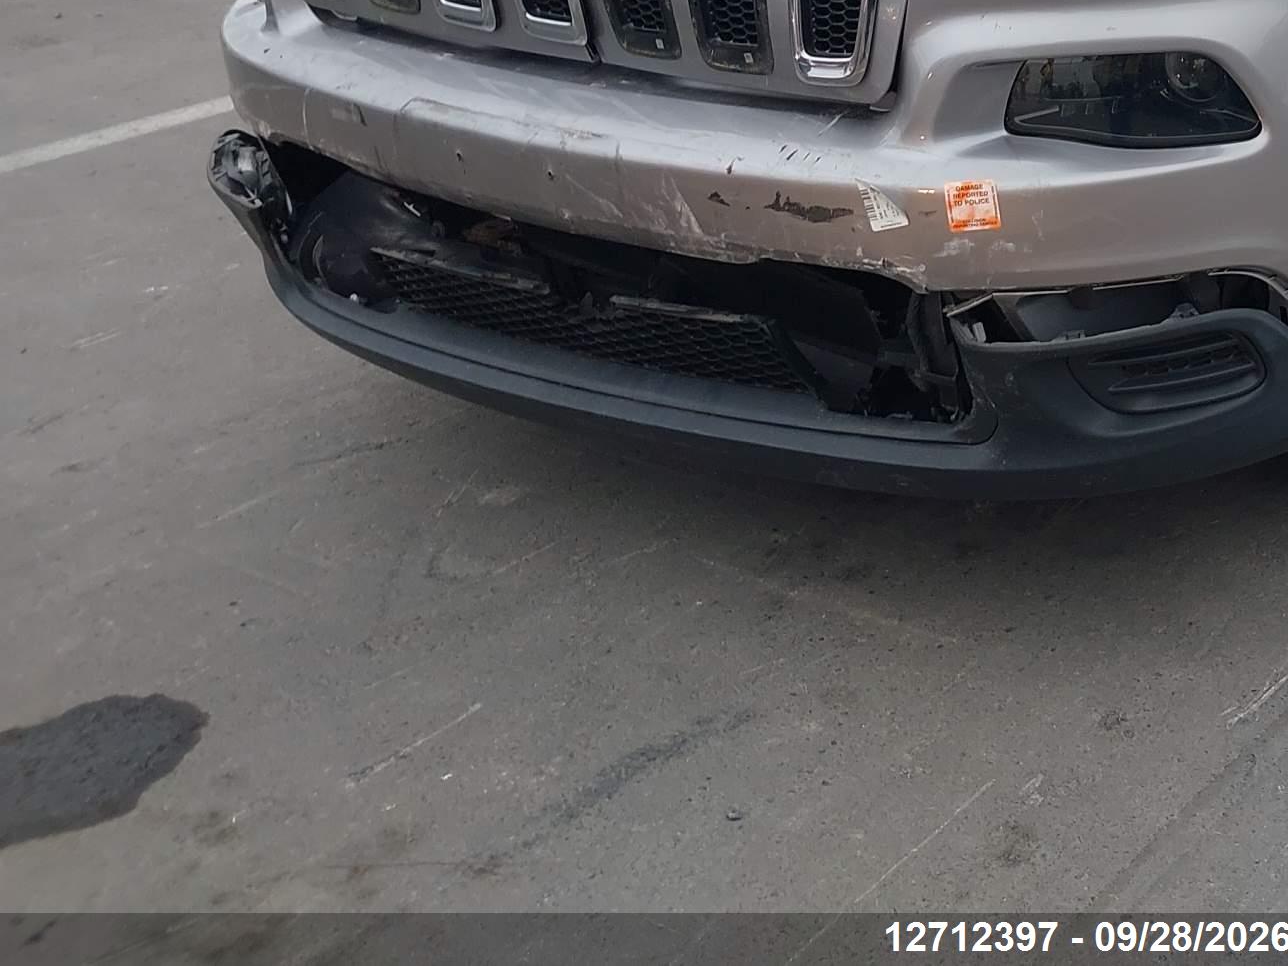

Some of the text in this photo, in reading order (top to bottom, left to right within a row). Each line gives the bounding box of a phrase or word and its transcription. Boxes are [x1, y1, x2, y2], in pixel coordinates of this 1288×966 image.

[955, 183, 984, 192] DAMAGE
[952, 191, 989, 199] REPORTED
[954, 197, 990, 207] TO POLICE
